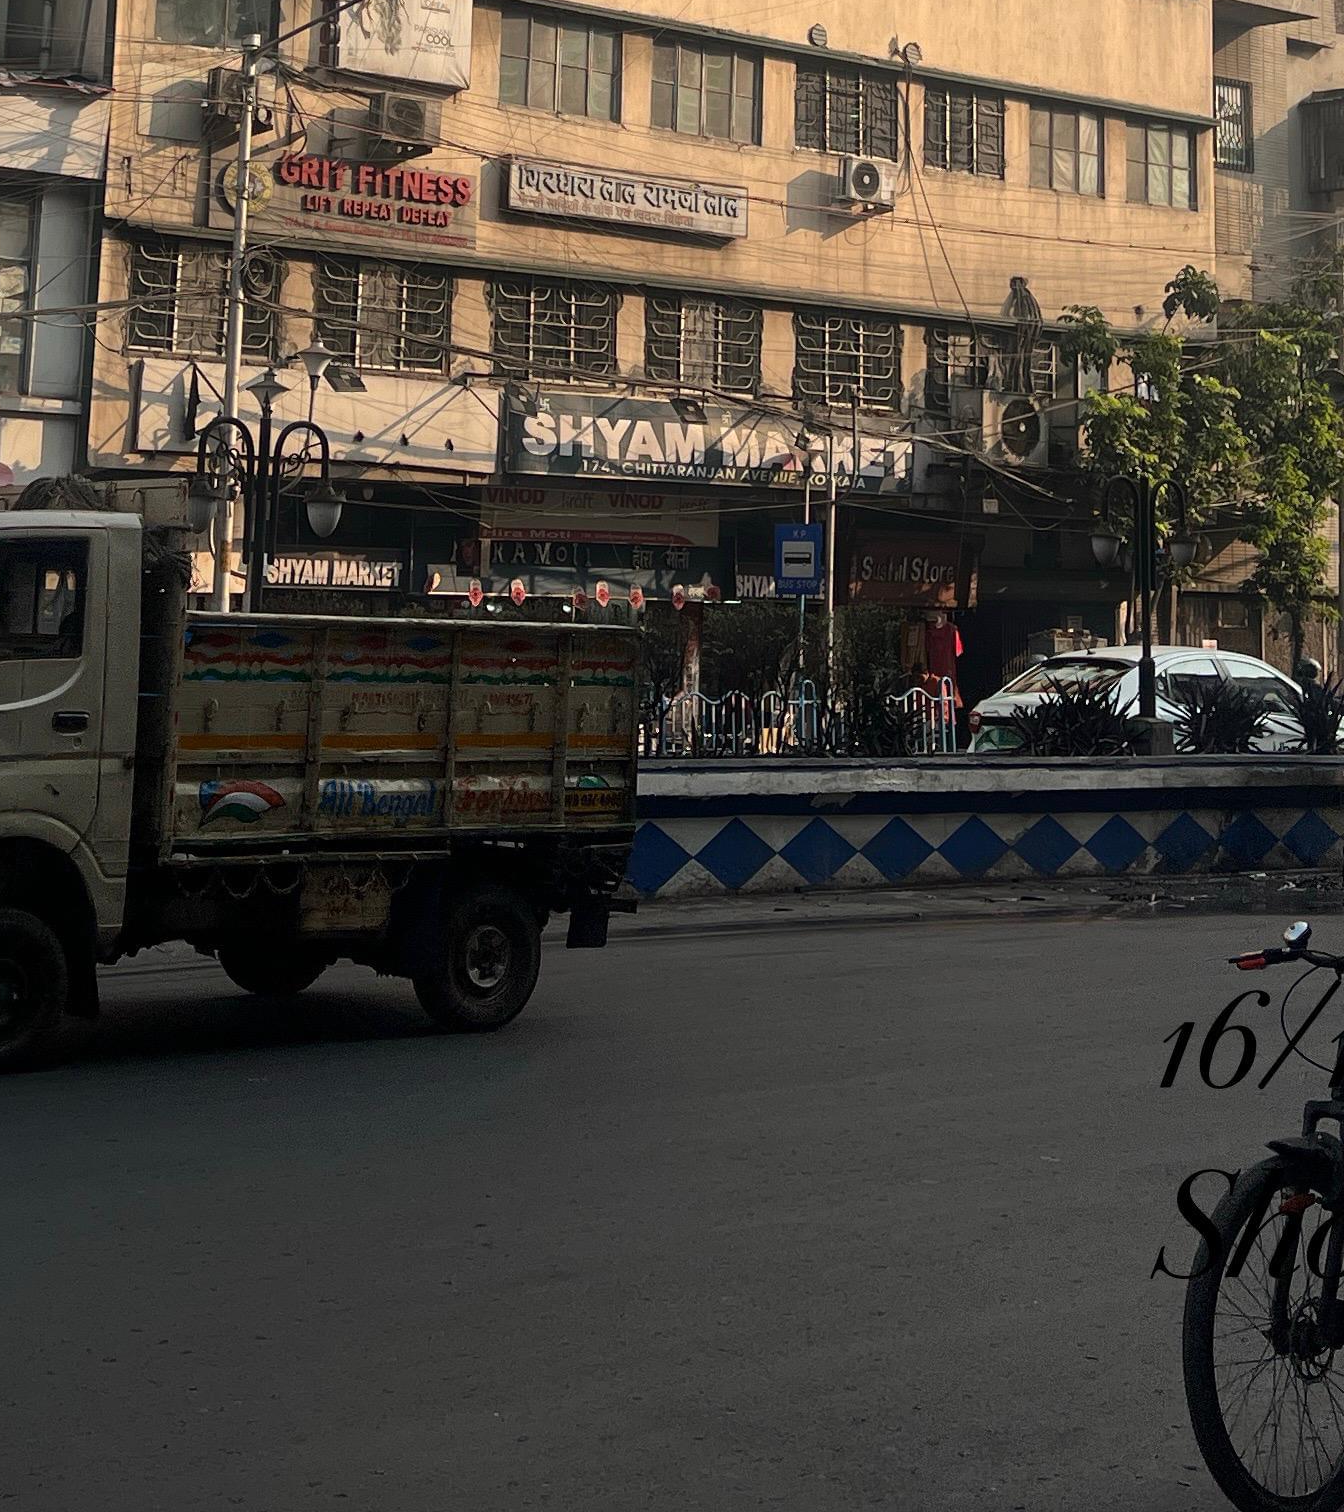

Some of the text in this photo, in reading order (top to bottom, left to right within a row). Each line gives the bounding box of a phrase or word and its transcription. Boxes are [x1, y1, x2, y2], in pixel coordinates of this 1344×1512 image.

[425, 33, 455, 48] COOL
[358, 164, 473, 206] FITNESS
[306, 194, 453, 227] LIFT REPEAT DEFEAT
[521, 411, 709, 466] SHYAM
[621, 461, 737, 482] CHITTARANJAN
[807, 474, 866, 489] KOKAA
[487, 488, 544, 504] VINOD
[608, 493, 664, 509] VINOD
[267, 557, 403, 587] SHYAM MARKET
[911, 556, 955, 582] Store
